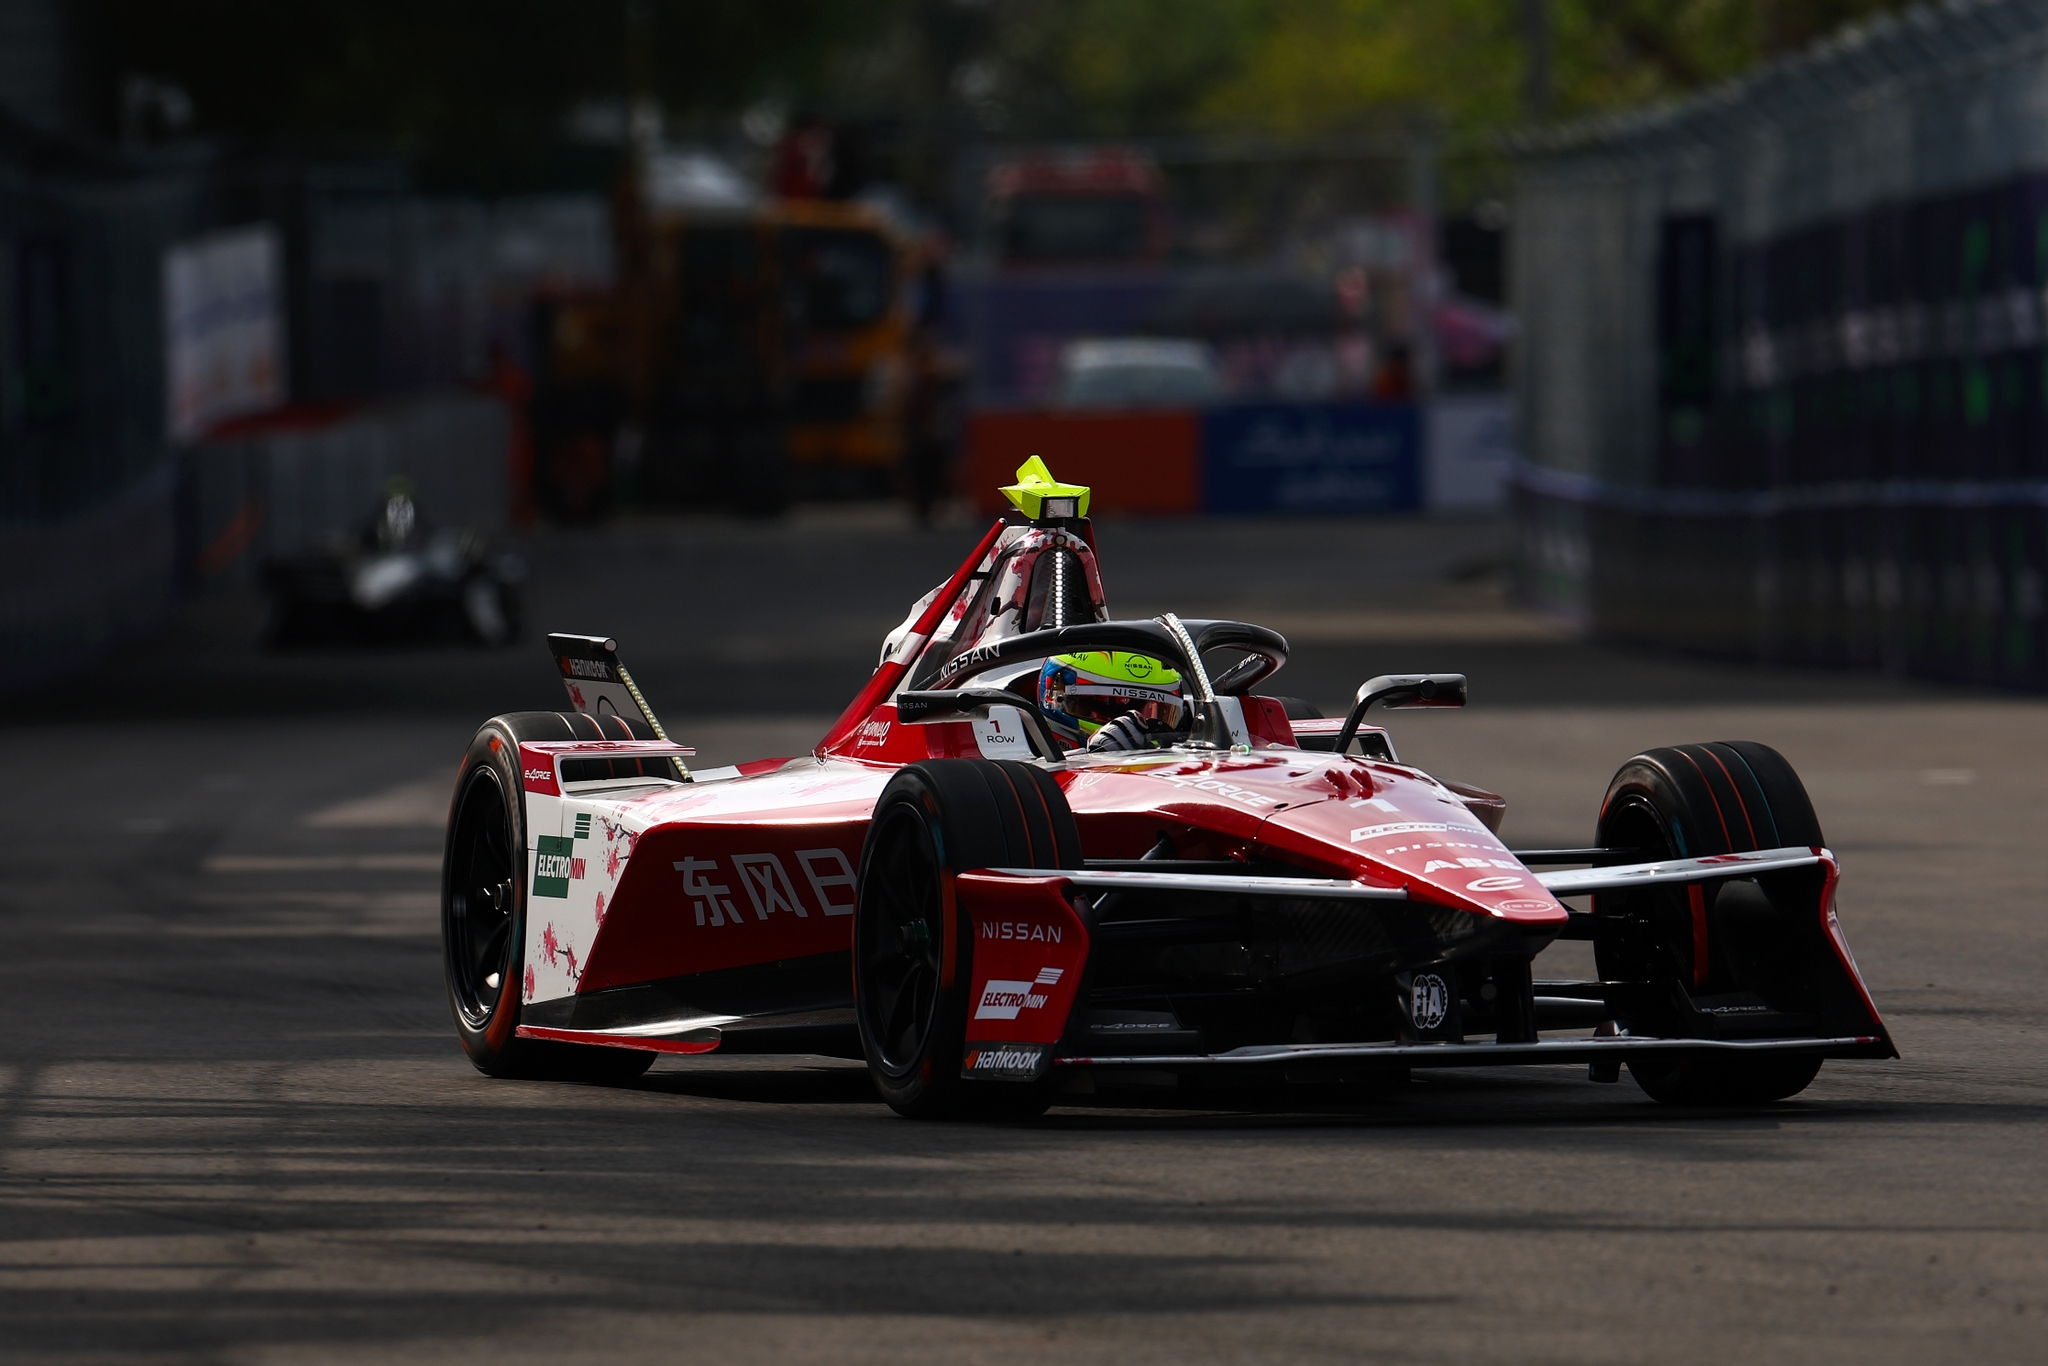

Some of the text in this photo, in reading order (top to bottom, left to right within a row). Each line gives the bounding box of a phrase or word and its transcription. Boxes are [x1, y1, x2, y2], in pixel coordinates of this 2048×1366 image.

[939, 643, 1001, 681] NISSAN
[1124, 662, 1153, 671] NISSAN
[1112, 687, 1166, 702] NISSAN
[898, 701, 928, 710] NISSAN
[989, 720, 1000, 733] 1
[987, 735, 1015, 744] ROW
[537, 854, 587, 880] ELECTROMIN
[1424, 857, 1524, 873] ABB
[982, 921, 1062, 944] NISSAN
[982, 992, 1049, 1009] ELECTROMIN
[1413, 986, 1442, 1016] FIA
